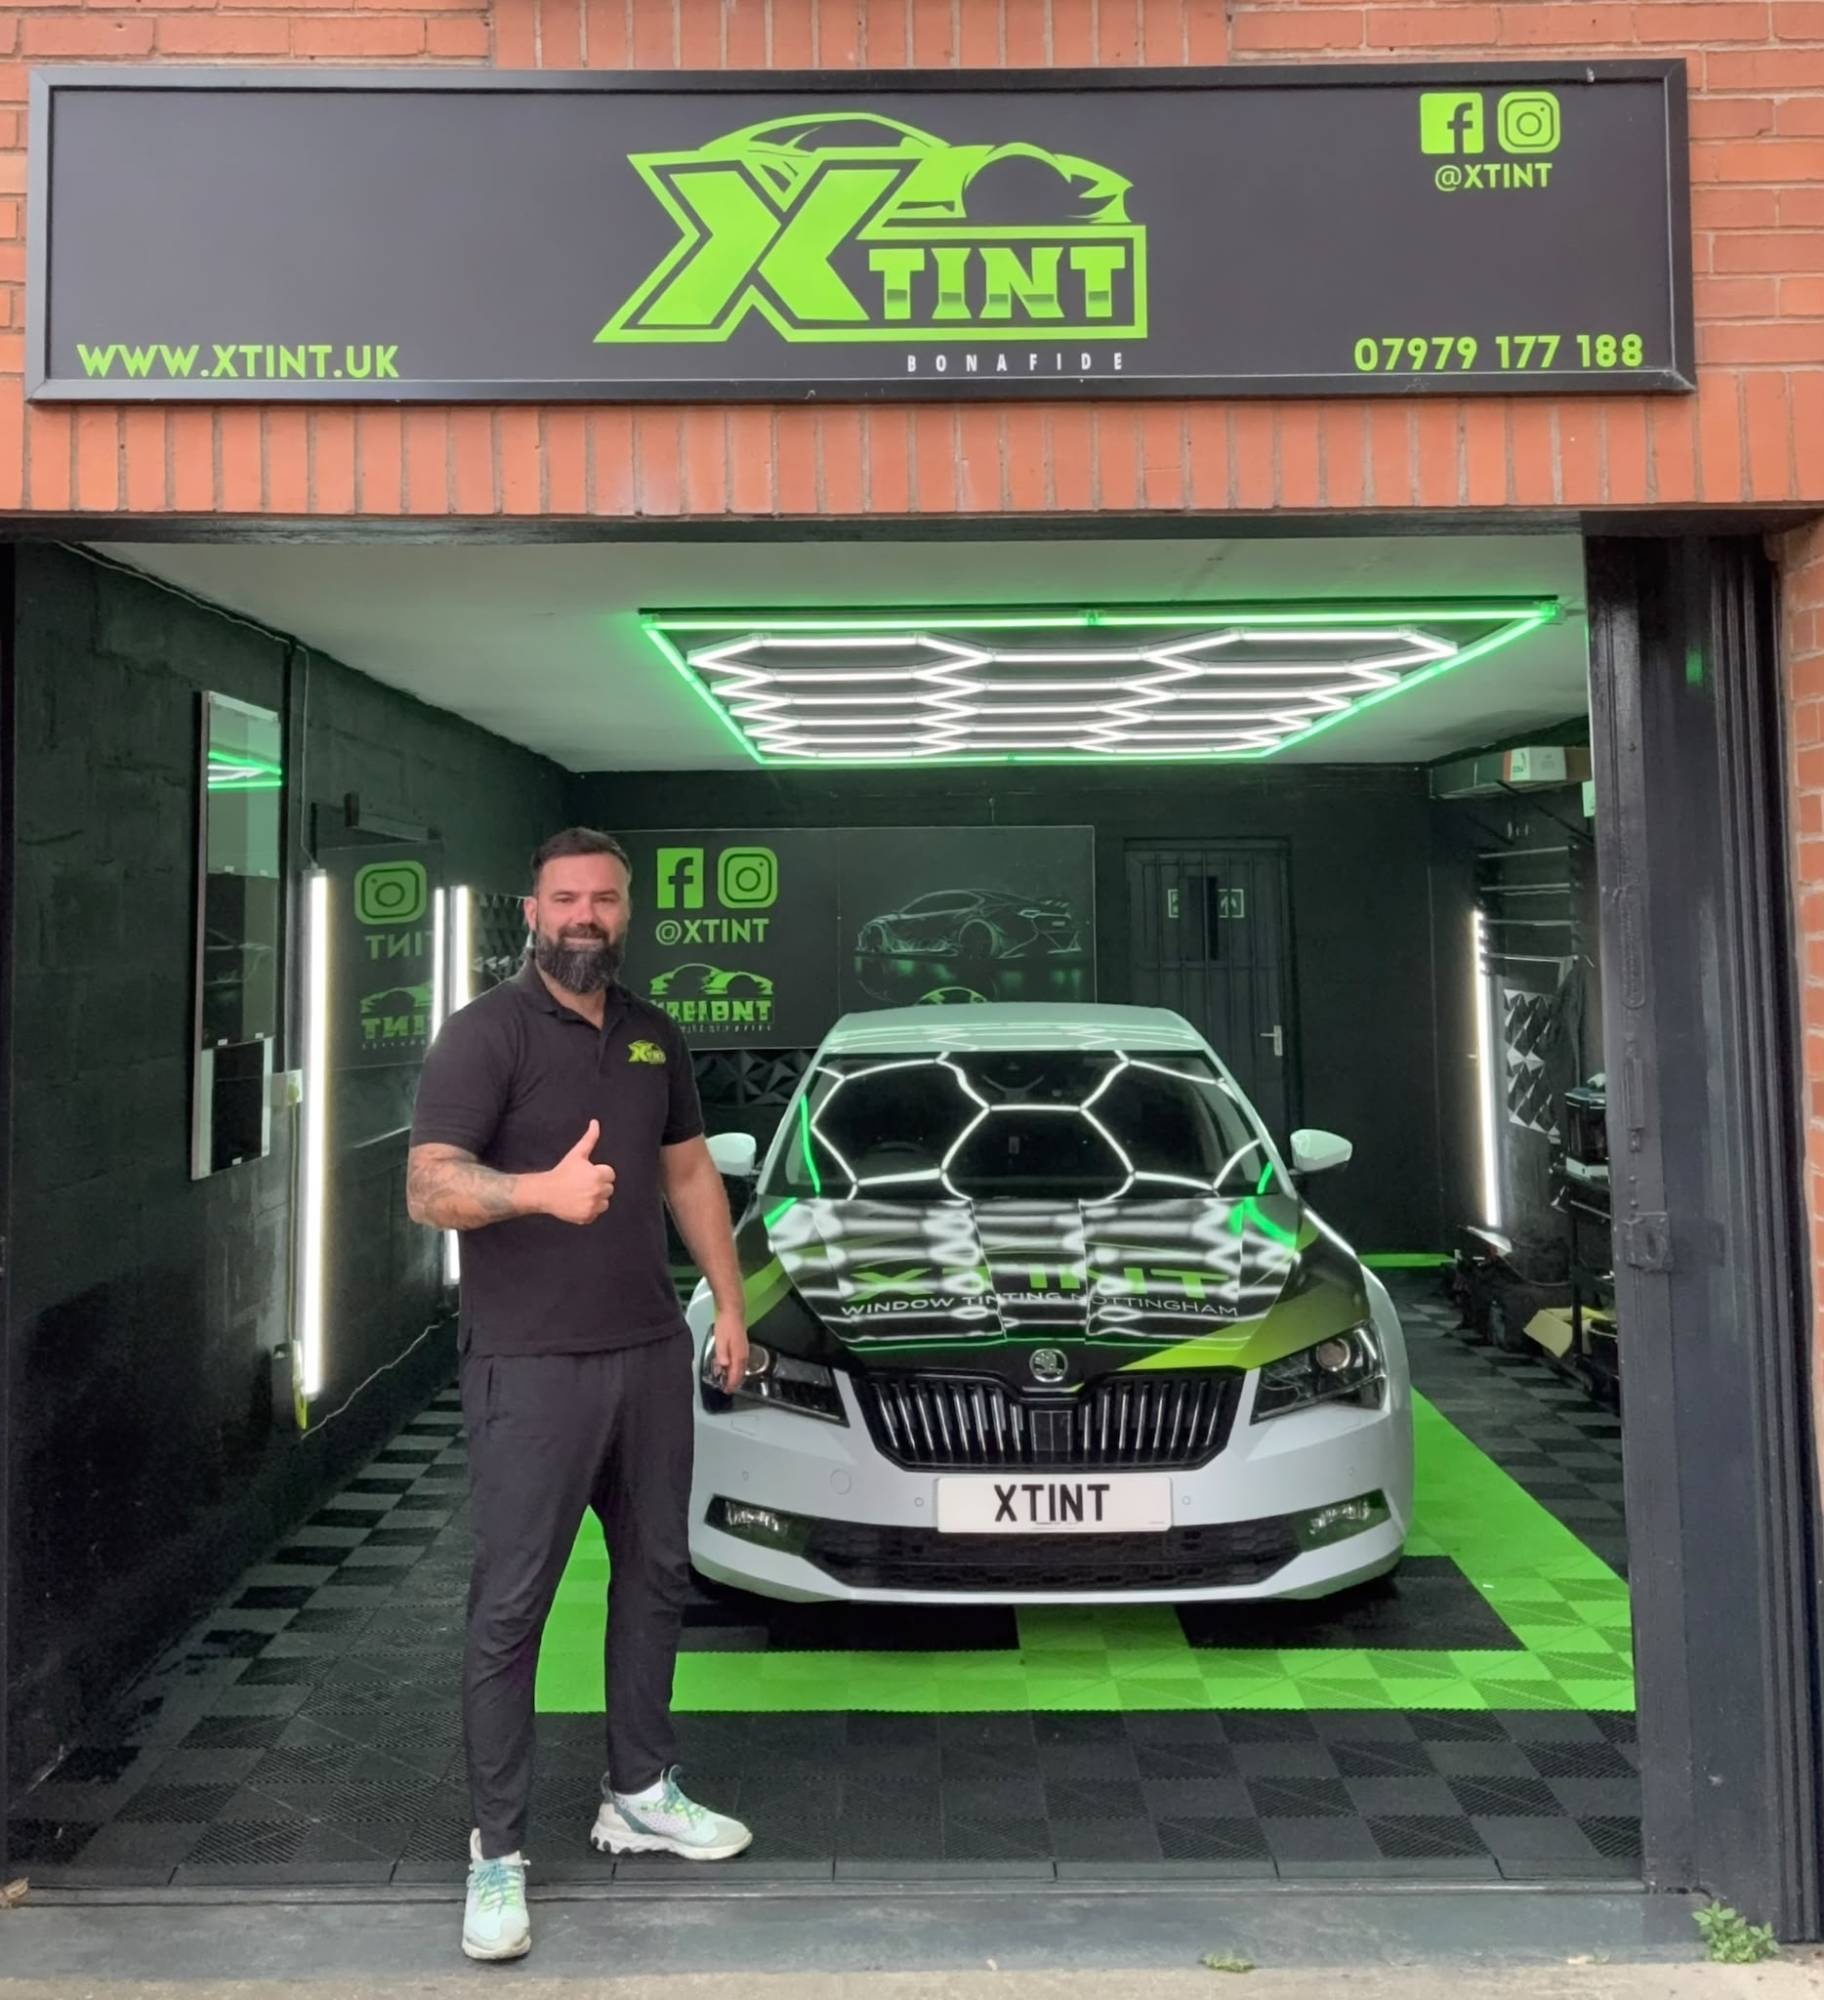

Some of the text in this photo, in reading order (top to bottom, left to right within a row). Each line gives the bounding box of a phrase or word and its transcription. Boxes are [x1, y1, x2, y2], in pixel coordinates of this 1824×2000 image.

[1435, 161, 1552, 192] @XTINT
[607, 156, 1136, 336] XTINT
[77, 344, 400, 380] WWW.XTINT.UK
[907, 352, 1123, 374] BONAFIDE
[1353, 331, 1645, 373] 07979 177 188
[655, 918, 770, 946] @XTINT
[841, 1296, 954, 1317] WINDOW
[962, 1291, 1063, 1306] TINTING
[993, 1483, 1110, 1522] XTINT
